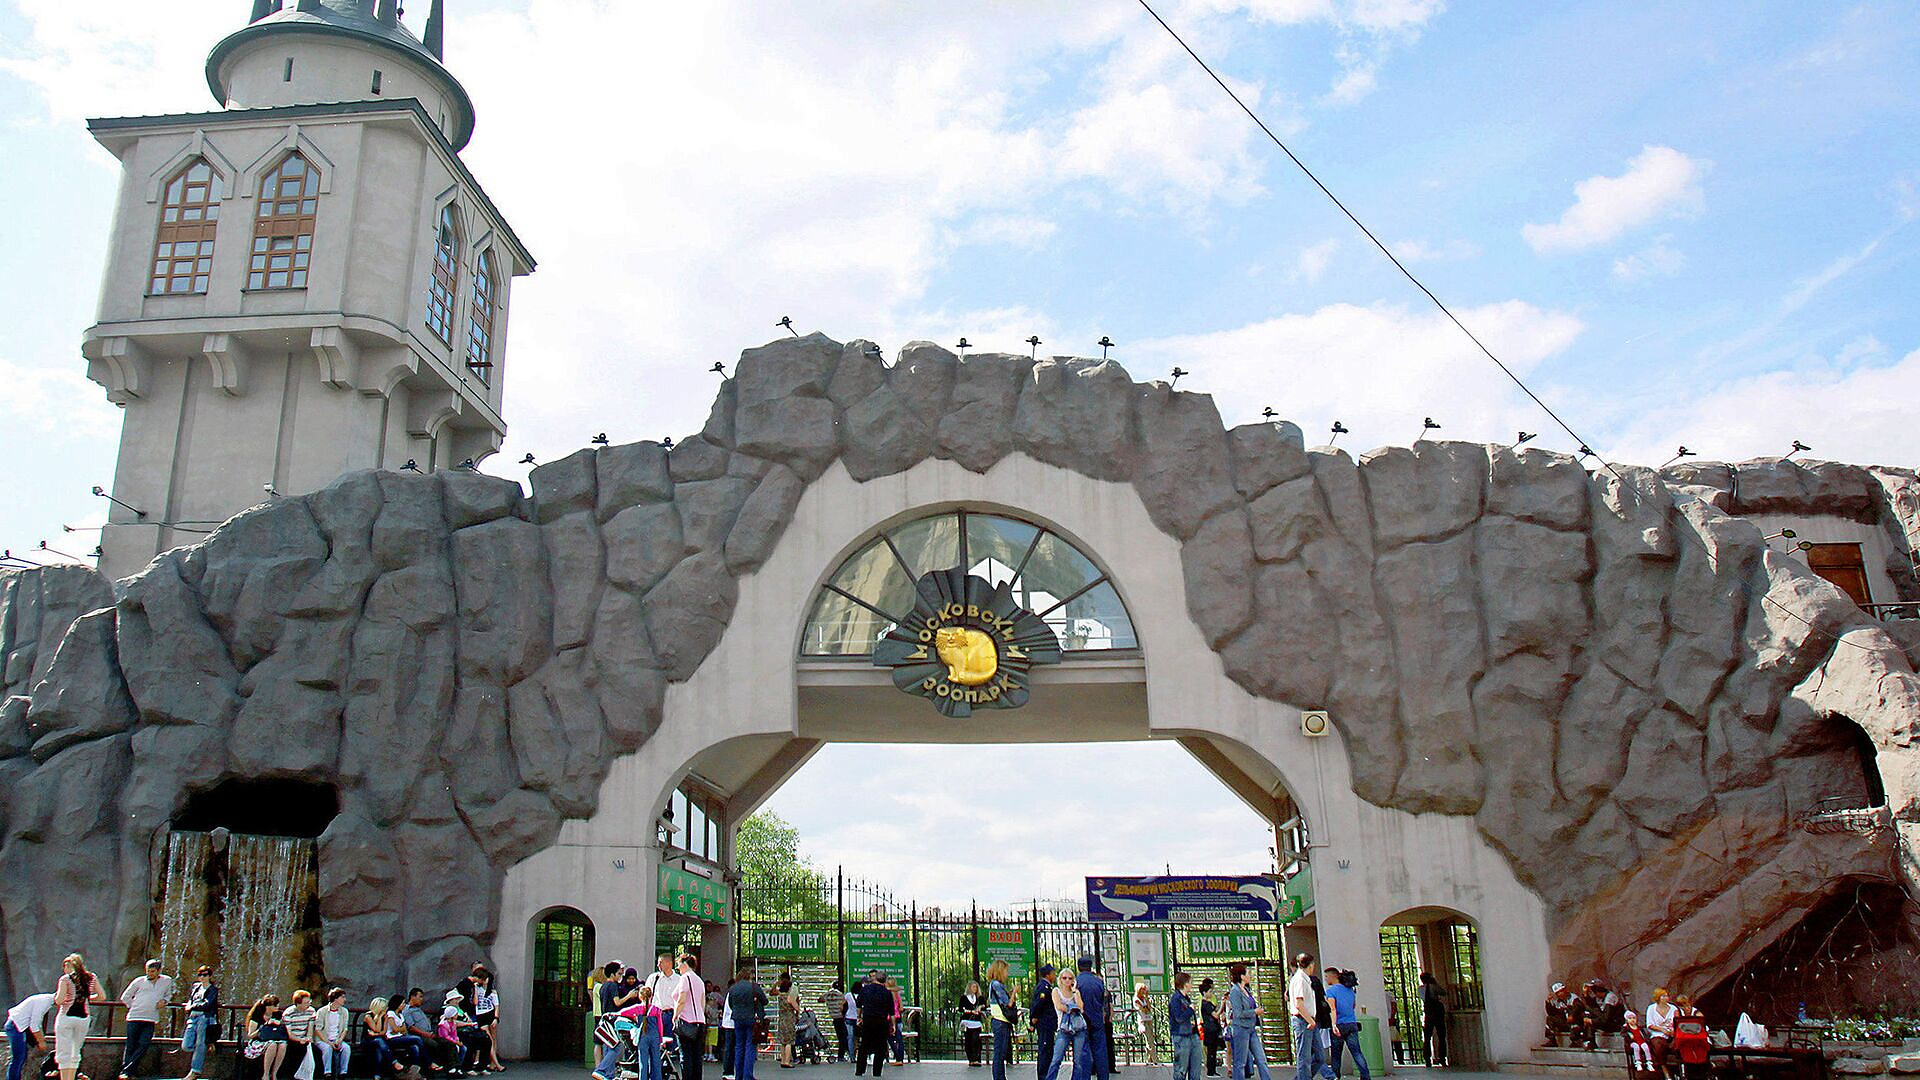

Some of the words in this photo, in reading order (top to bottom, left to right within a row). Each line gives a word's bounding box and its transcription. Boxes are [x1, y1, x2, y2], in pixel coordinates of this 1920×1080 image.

[904, 602, 1029, 659] МОСКОВСКИЙ
[923, 674, 1022, 703] ЗООПАРК
[1158, 880, 1204, 893] МОСКОВСКОГО
[1205, 880, 1239, 892] ЗООПАРКА
[678, 894, 685, 908] 1
[691, 898, 699, 912] 2
[704, 903, 712, 915] 3
[718, 907, 725, 919] 4
[756, 933, 792, 950] ВХОДА
[798, 933, 819, 949] НЕТ
[989, 931, 1022, 944] ВХОД
[1192, 935, 1232, 953] ВХОДА
[1236, 935, 1258, 952] НЕТ
